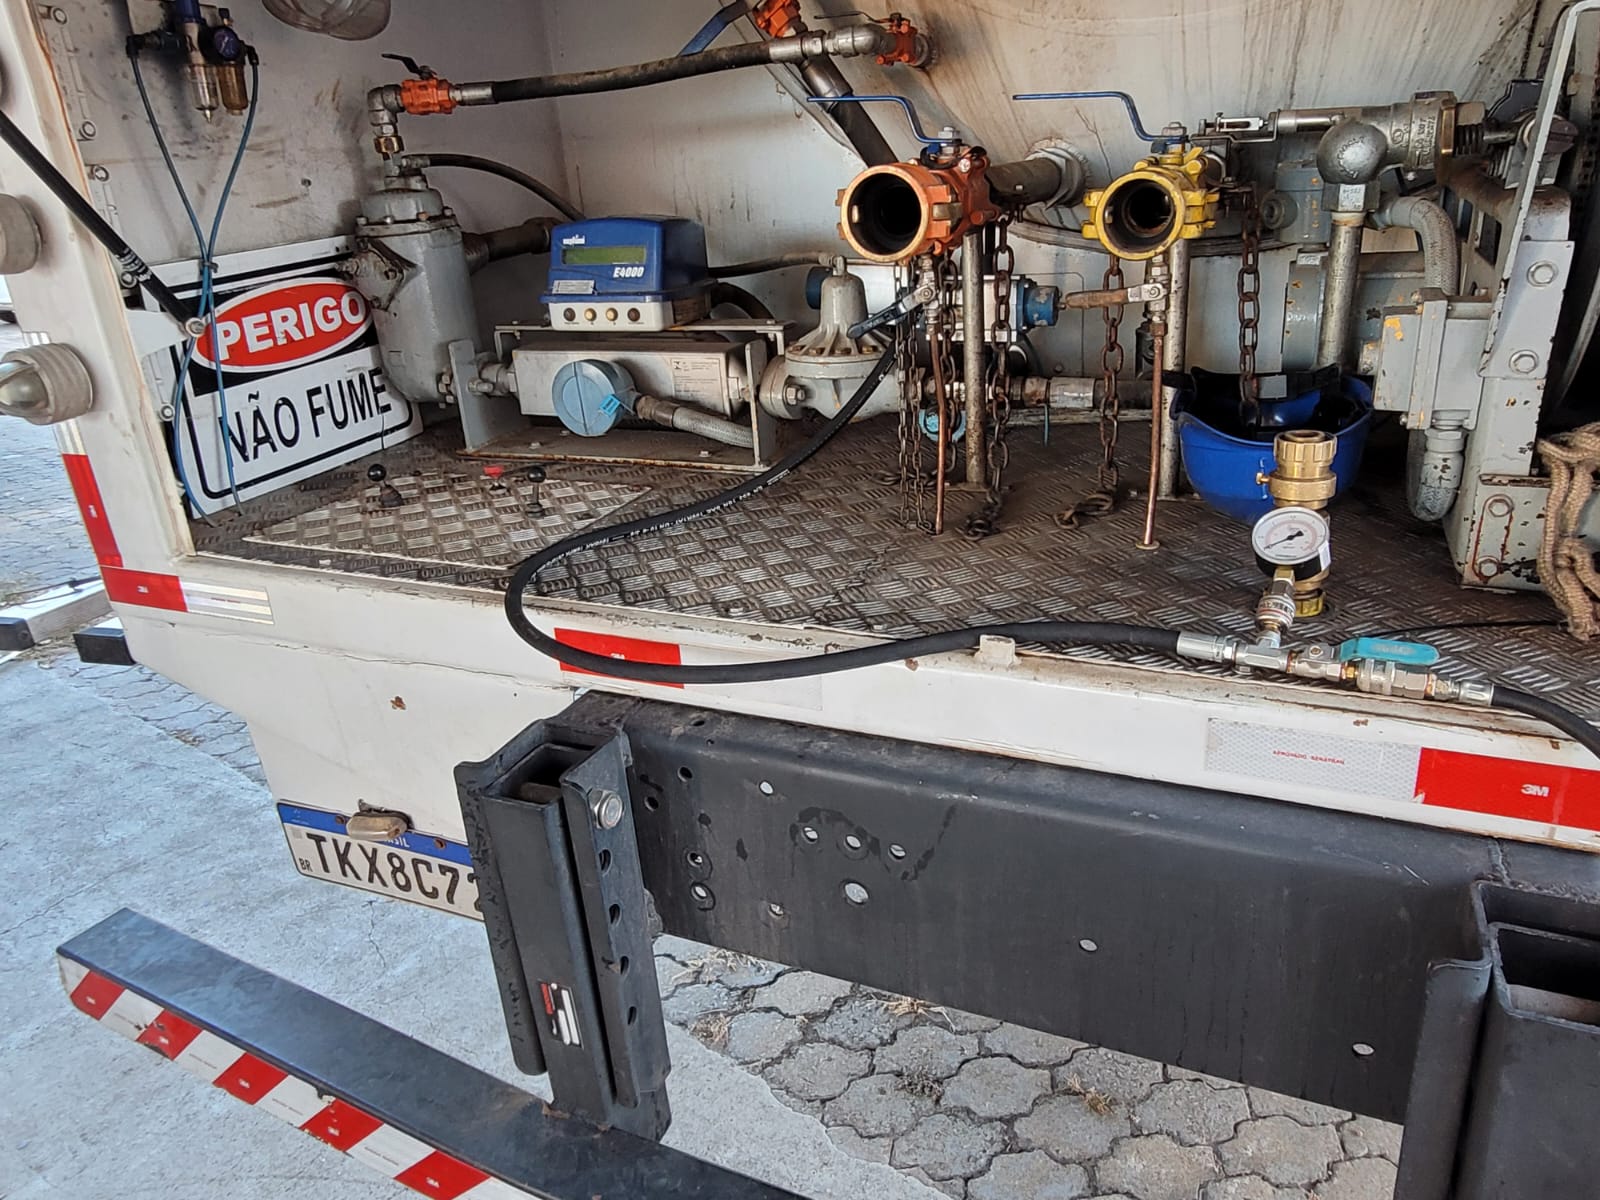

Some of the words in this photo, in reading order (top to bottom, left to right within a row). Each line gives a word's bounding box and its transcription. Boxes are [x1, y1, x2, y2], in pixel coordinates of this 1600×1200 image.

[612, 266, 645, 278] E4000
[215, 290, 367, 361] PERIGO
[218, 390, 300, 463] NÃO
[306, 367, 392, 438] FUME
[1520, 783, 1550, 798] 3M
[299, 858, 313, 873] BR
